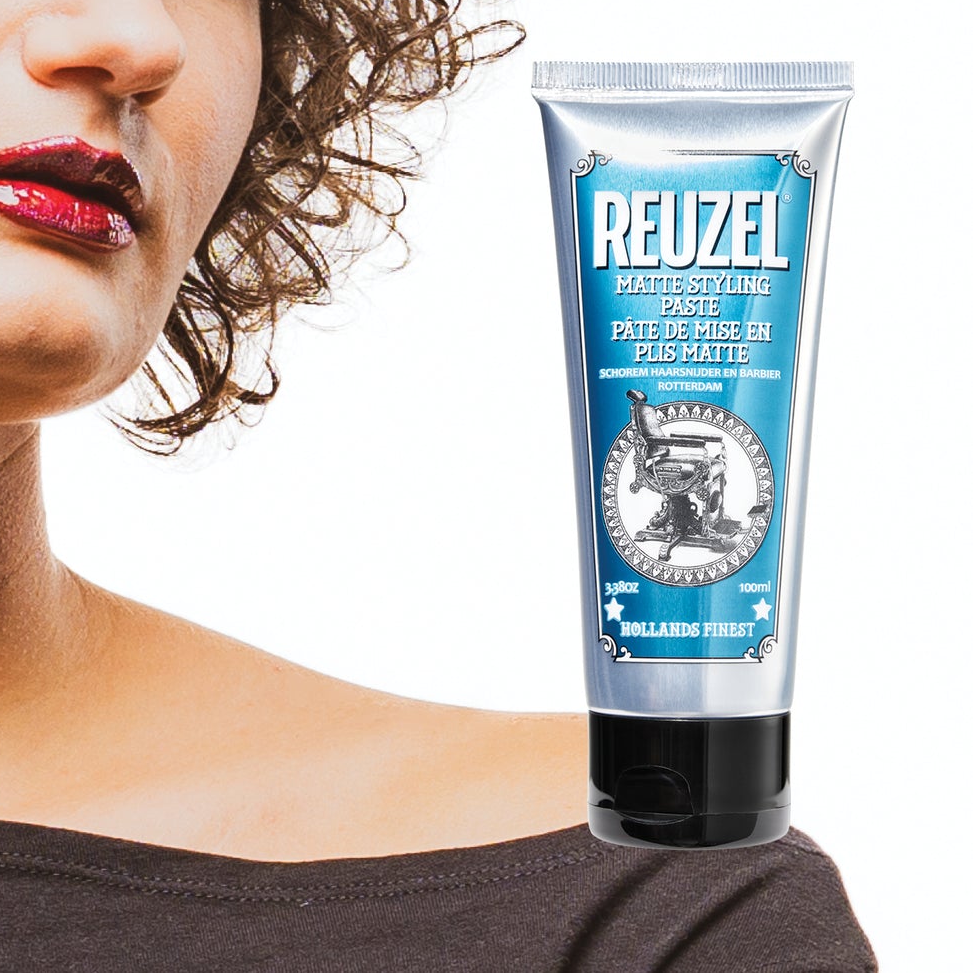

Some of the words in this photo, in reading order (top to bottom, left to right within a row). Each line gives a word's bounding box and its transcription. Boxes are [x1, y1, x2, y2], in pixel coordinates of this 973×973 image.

[593, 190, 790, 271] REUZEL
[615, 275, 684, 296] MATTE
[687, 271, 771, 296] STYLING
[660, 297, 720, 317] PASTE
[611, 316, 659, 341] PÂTE
[664, 321, 689, 341] DE
[694, 321, 741, 341] MISE
[746, 322, 772, 342] EN
[634, 343, 677, 363] PLIS
[681, 343, 749, 364] MATTE
[599, 368, 648, 379] SCHOREM
[651, 368, 722, 378] HAARSNIJDER
[723, 368, 737, 378] EN
[739, 369, 781, 379] BARBIER
[658, 382, 723, 392] ROTTERDAM
[739, 580, 771, 593] 100ml
[619, 621, 700, 637] HOLLANDS
[702, 622, 756, 637] FINEST
